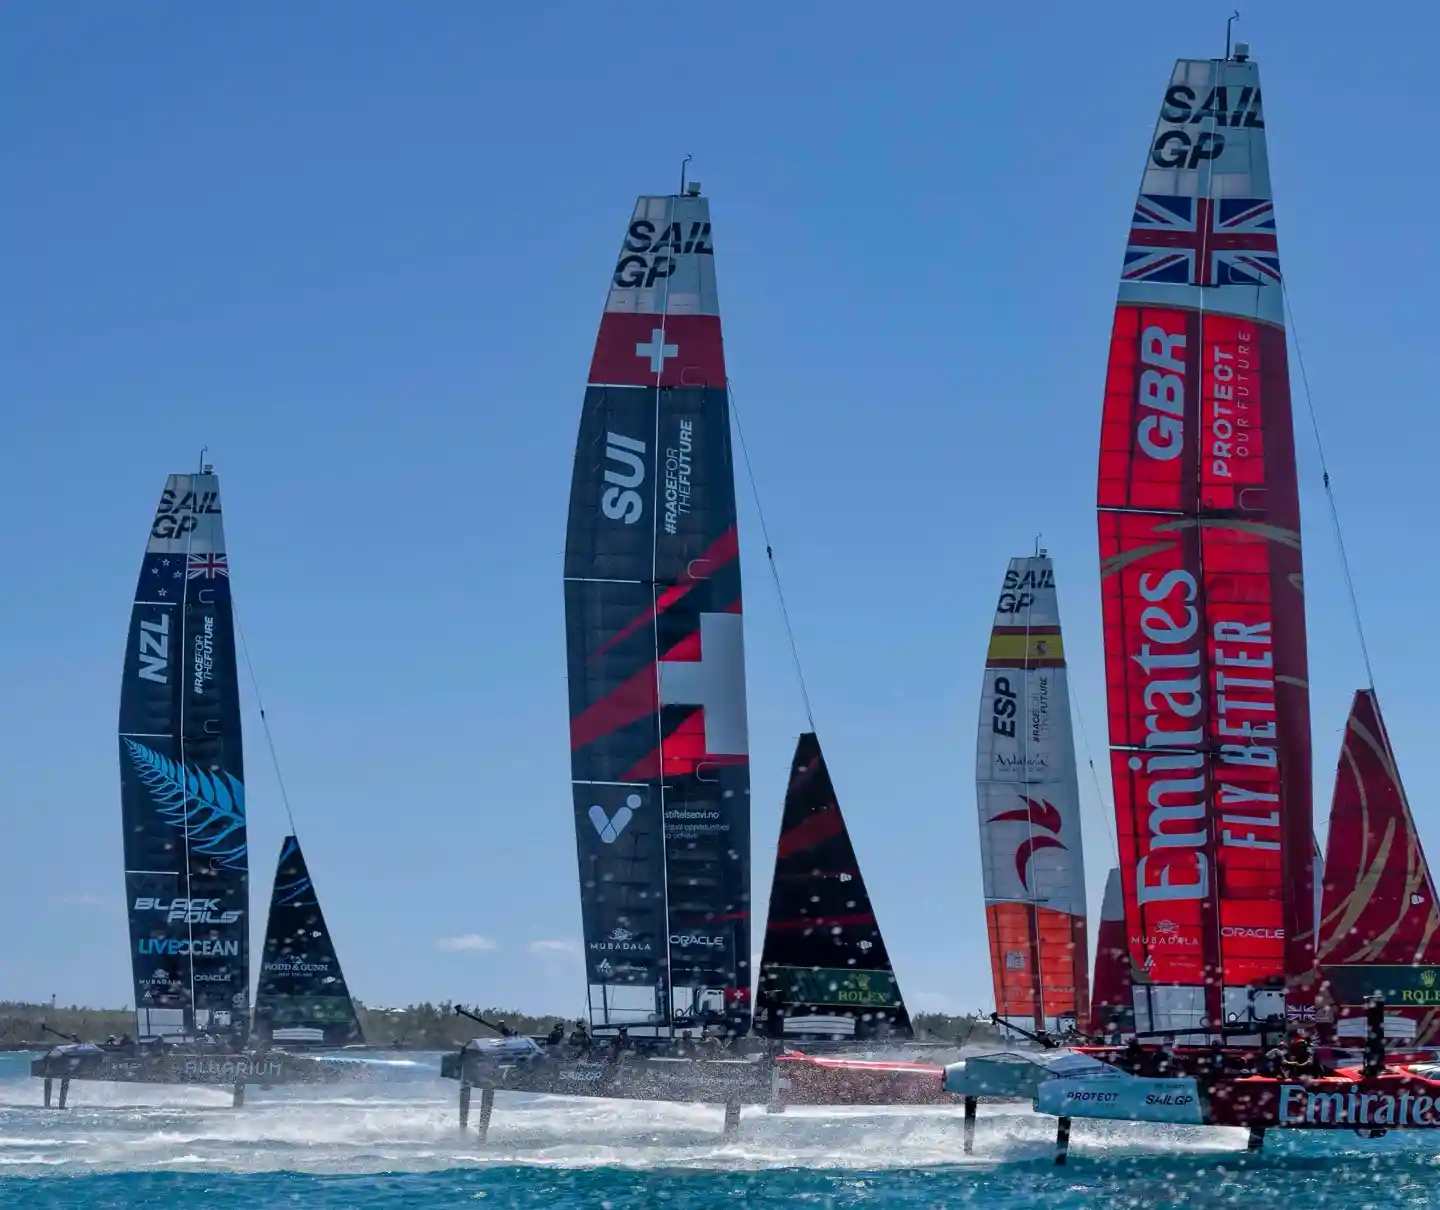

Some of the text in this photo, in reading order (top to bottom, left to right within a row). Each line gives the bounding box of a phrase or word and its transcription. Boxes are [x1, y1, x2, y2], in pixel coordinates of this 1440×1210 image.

[1161, 85, 1265, 129] SAIL
[1151, 131, 1225, 170] GP
[626, 220, 714, 255] SAIL
[614, 256, 676, 288] GP
[1138, 326, 1187, 461] GBR
[1236, 331, 1250, 457] OUR FUTURE
[1213, 346, 1234, 478] PROTECT
[602, 432, 646, 524] SUI
[157, 489, 222, 514] SAIL
[151, 515, 198, 539] GP
[1003, 570, 1056, 590] SAIL
[997, 593, 1034, 613] GP
[138, 613, 170, 683] NZL
[993, 677, 1017, 738] ESP
[1128, 569, 1209, 907] Emirates
[1213, 621, 1282, 852] FLY BETTER
[134, 898, 221, 911] BLACK
[167, 910, 244, 923] FOILS
[670, 935, 724, 946] ORACLE
[1131, 936, 1199, 946] MUBADALA
[1221, 927, 1285, 939] ORACLE
[194, 974, 231, 982] ORACLE
[300, 963, 329, 972] GUNN
[838, 990, 886, 1003] ROLEX
[1066, 1092, 1119, 1101] PROTECT
[1145, 1094, 1194, 1106] SAILGP
